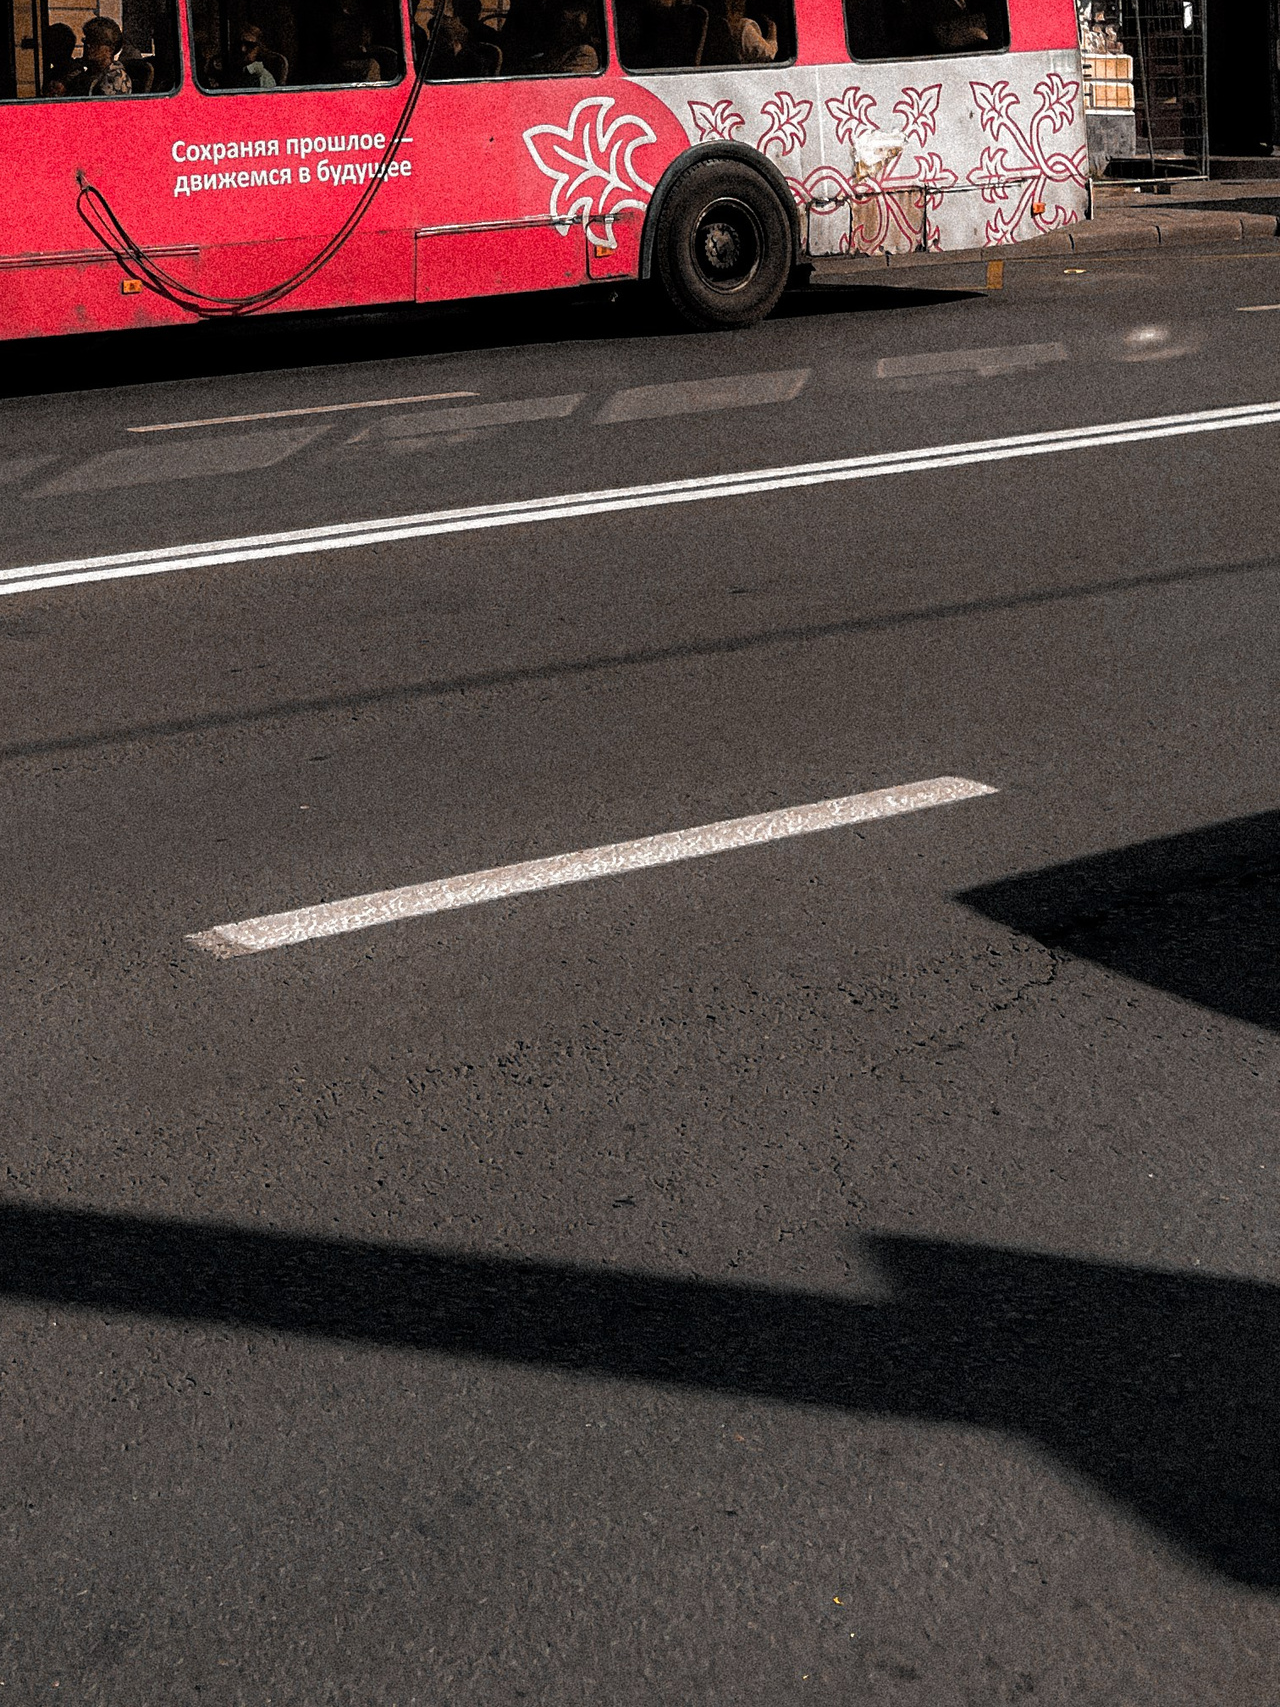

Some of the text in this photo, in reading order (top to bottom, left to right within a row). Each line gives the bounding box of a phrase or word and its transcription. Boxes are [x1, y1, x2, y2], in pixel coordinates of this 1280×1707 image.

[171, 140, 280, 165] Сохраняя
[286, 132, 386, 159] прошлое
[173, 158, 413, 198] движемся в будущее
